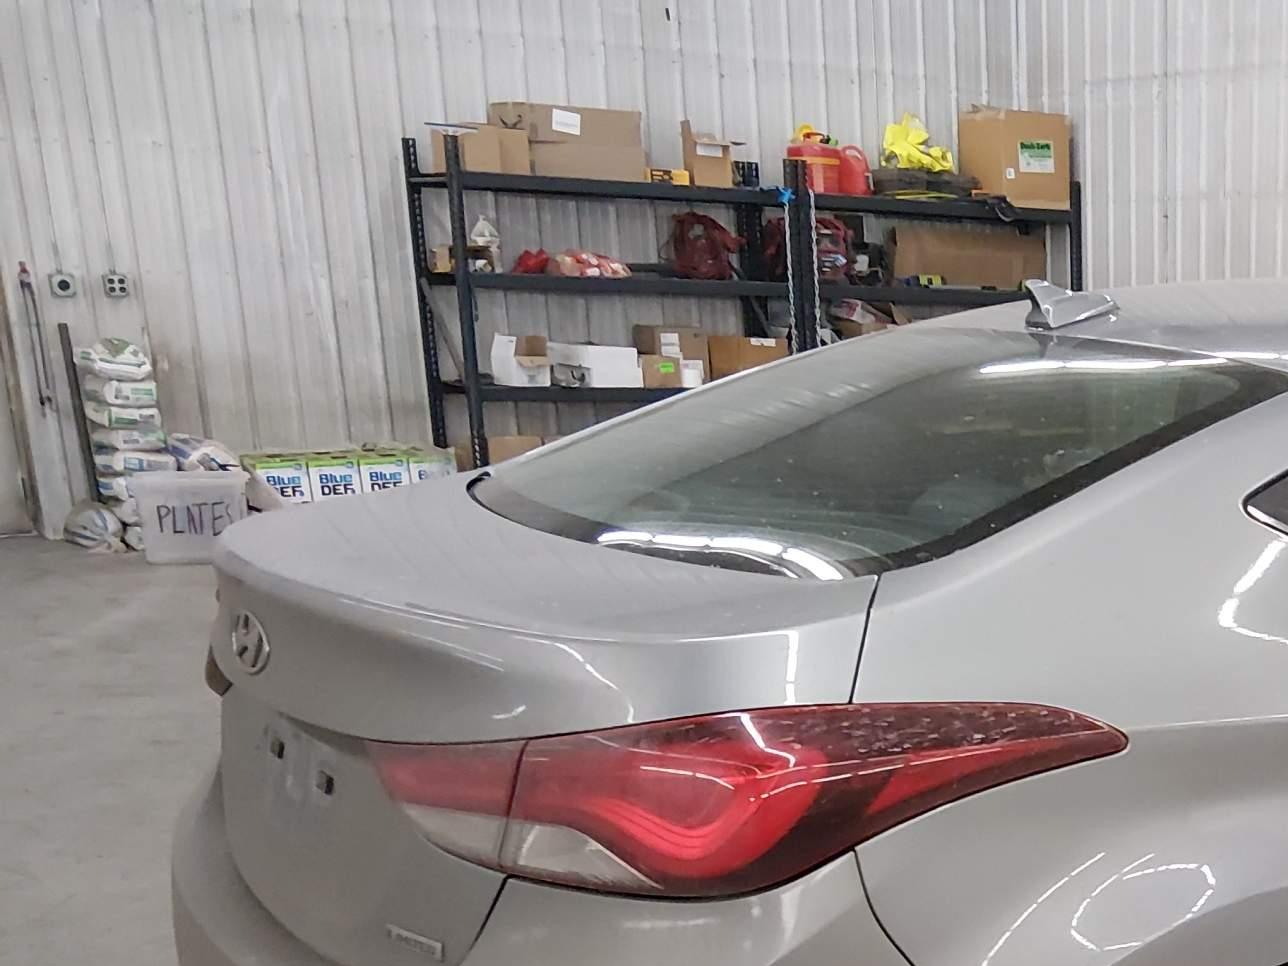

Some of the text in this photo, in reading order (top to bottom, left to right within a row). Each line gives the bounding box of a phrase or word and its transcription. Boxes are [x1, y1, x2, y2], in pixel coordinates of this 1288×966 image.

[266, 475, 301, 486] Blue
[319, 473, 353, 484] Blue
[369, 471, 402, 482] Blue
[274, 486, 305, 498] EF
[321, 484, 356, 496] DEF
